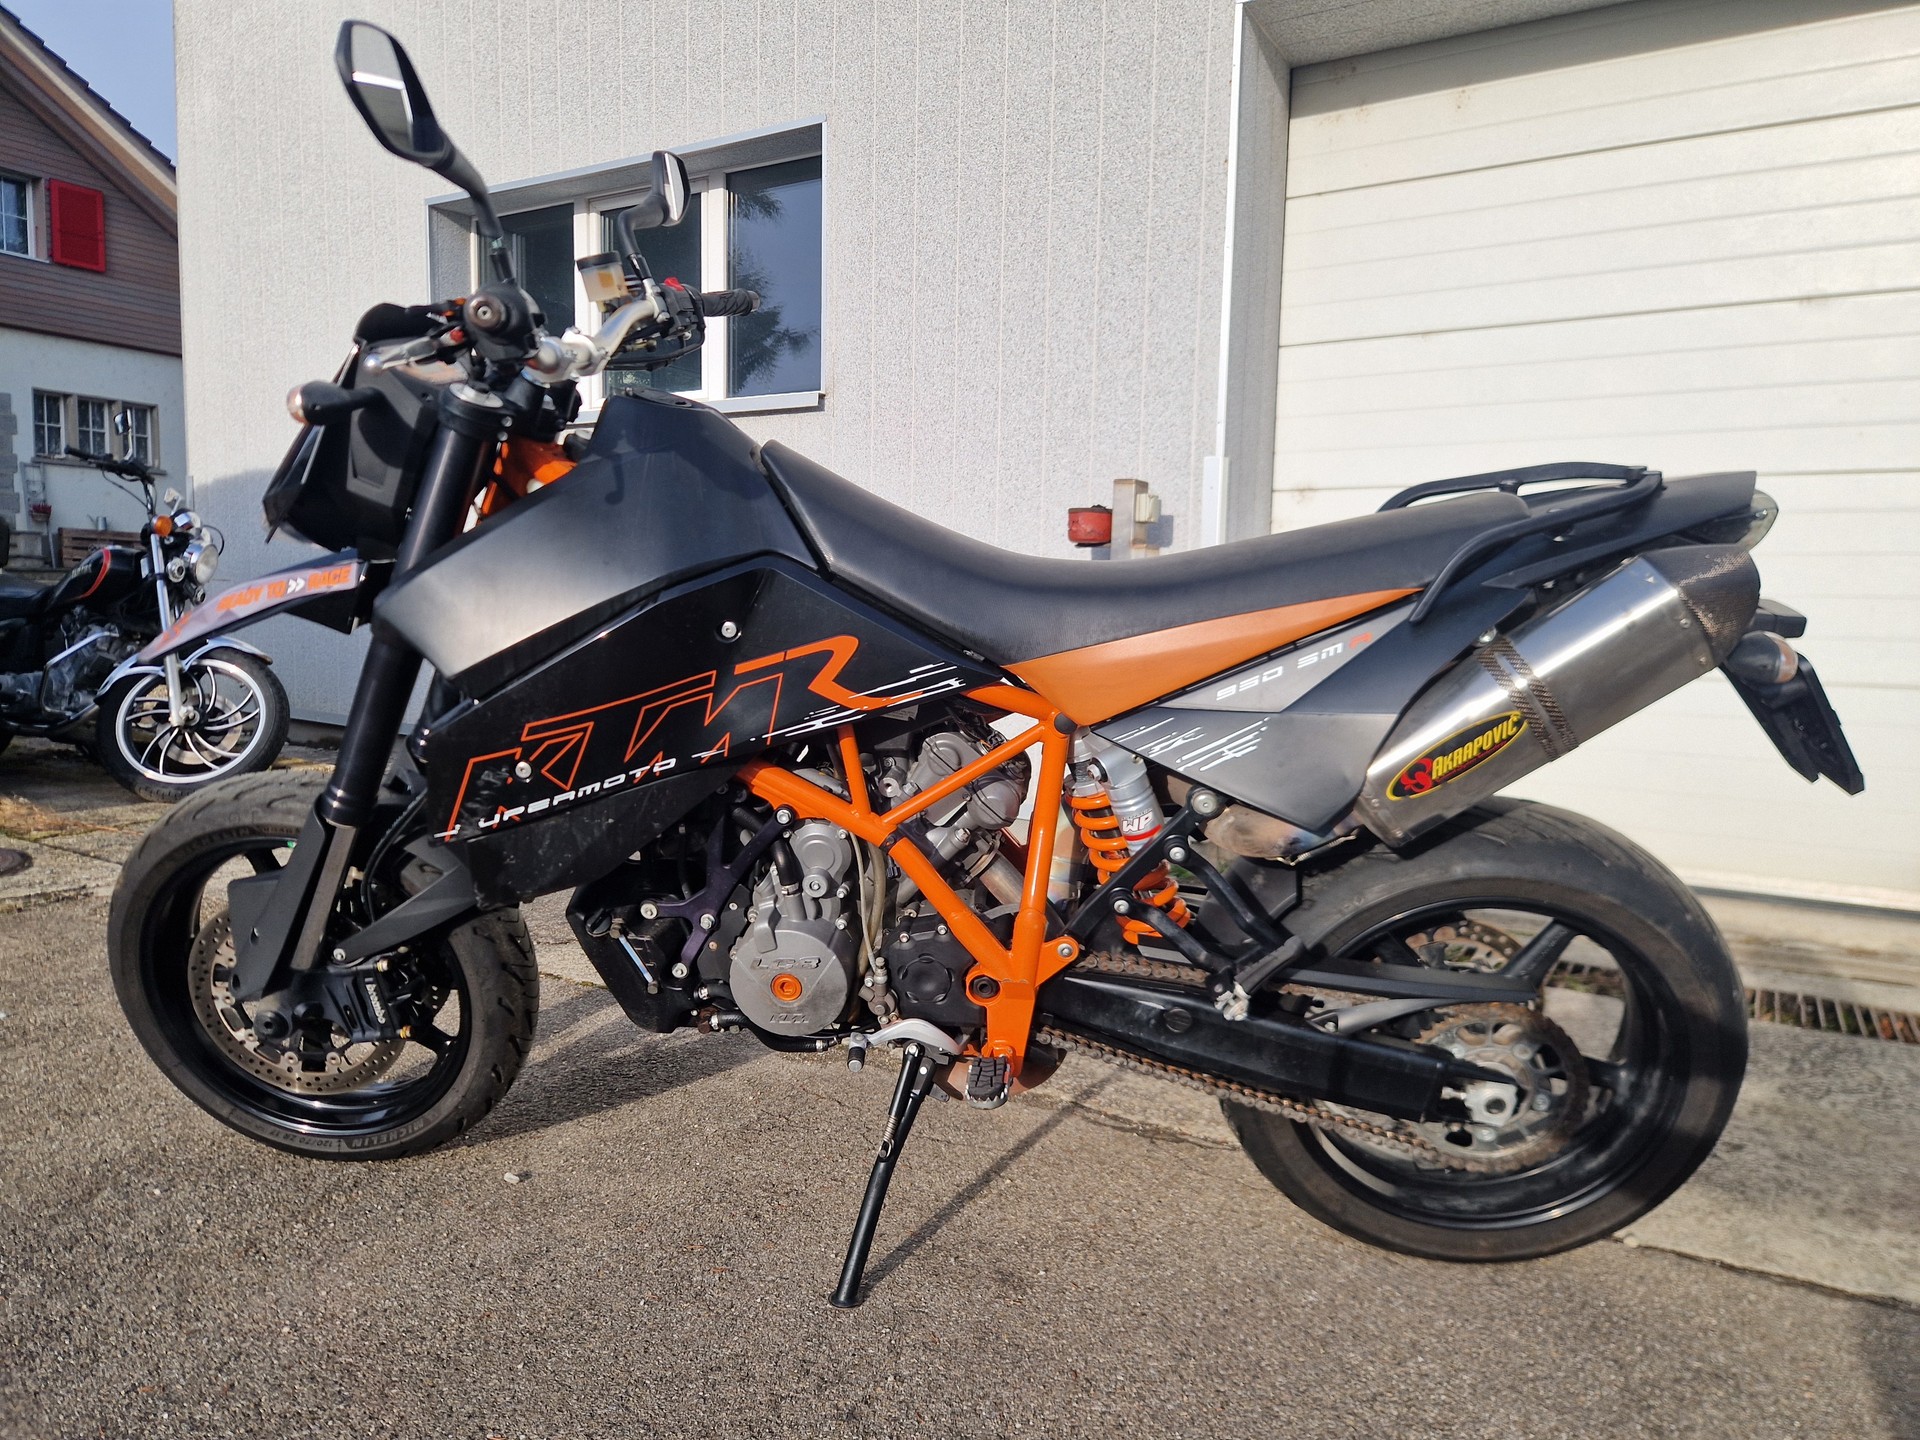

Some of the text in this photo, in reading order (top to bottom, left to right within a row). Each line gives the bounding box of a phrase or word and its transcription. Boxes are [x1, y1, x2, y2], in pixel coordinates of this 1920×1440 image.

[265, 580, 287, 600] TO
[306, 564, 353, 592] RACE
[1216, 666, 1284, 701] 950
[1121, 810, 1153, 833] WP
[750, 955, 822, 970] LC8
[282, 1132, 297, 1143] ZR
[298, 1136, 334, 1148] 120/70
[351, 1121, 426, 1150] MICHELIN
